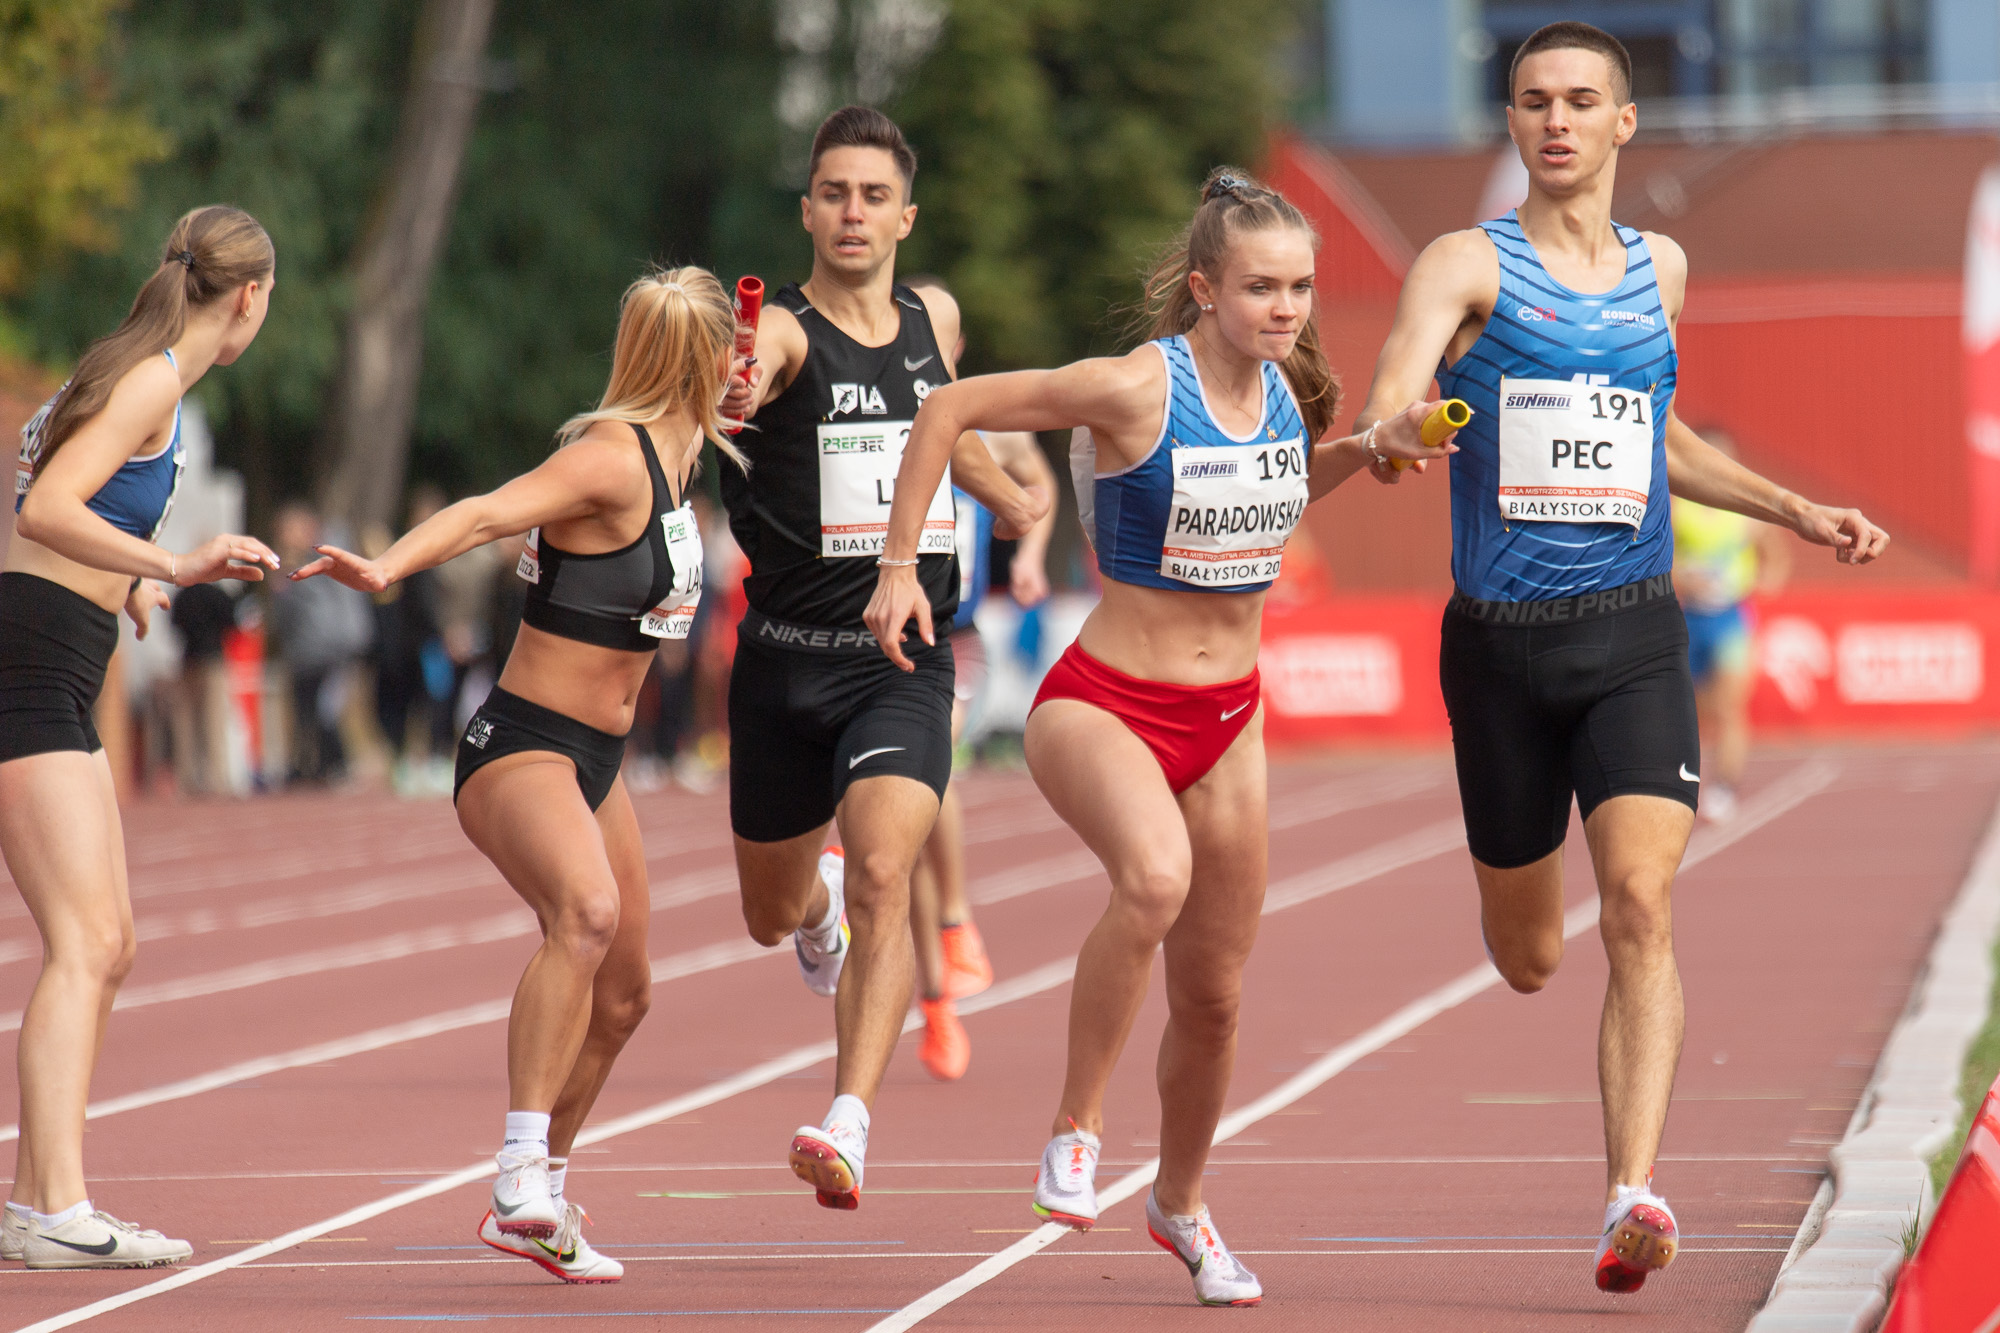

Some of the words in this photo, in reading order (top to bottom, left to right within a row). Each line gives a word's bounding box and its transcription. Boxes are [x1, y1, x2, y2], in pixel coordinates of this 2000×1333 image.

[1506, 394, 1572, 409] SONAROL
[1589, 392, 1646, 425] 191
[1180, 461, 1239, 478] SONAROL
[1256, 446, 1301, 481] 190
[1552, 439, 1613, 470] PEC
[876, 478, 896, 506] L
[1174, 497, 1303, 537] PARADOWSKA
[1509, 502, 1605, 516] BIAŁYSTOK
[1613, 503, 1642, 522] 2022
[832, 536, 921, 552] BIAŁYS
[1172, 562, 1259, 581] BIAŁYSTOK
[1264, 560, 1280, 576] 20
[1493, 599, 1571, 623] NIKE
[1576, 585, 1639, 618] PRO
[760, 621, 832, 648] NIKE
[833, 631, 879, 648] PR
